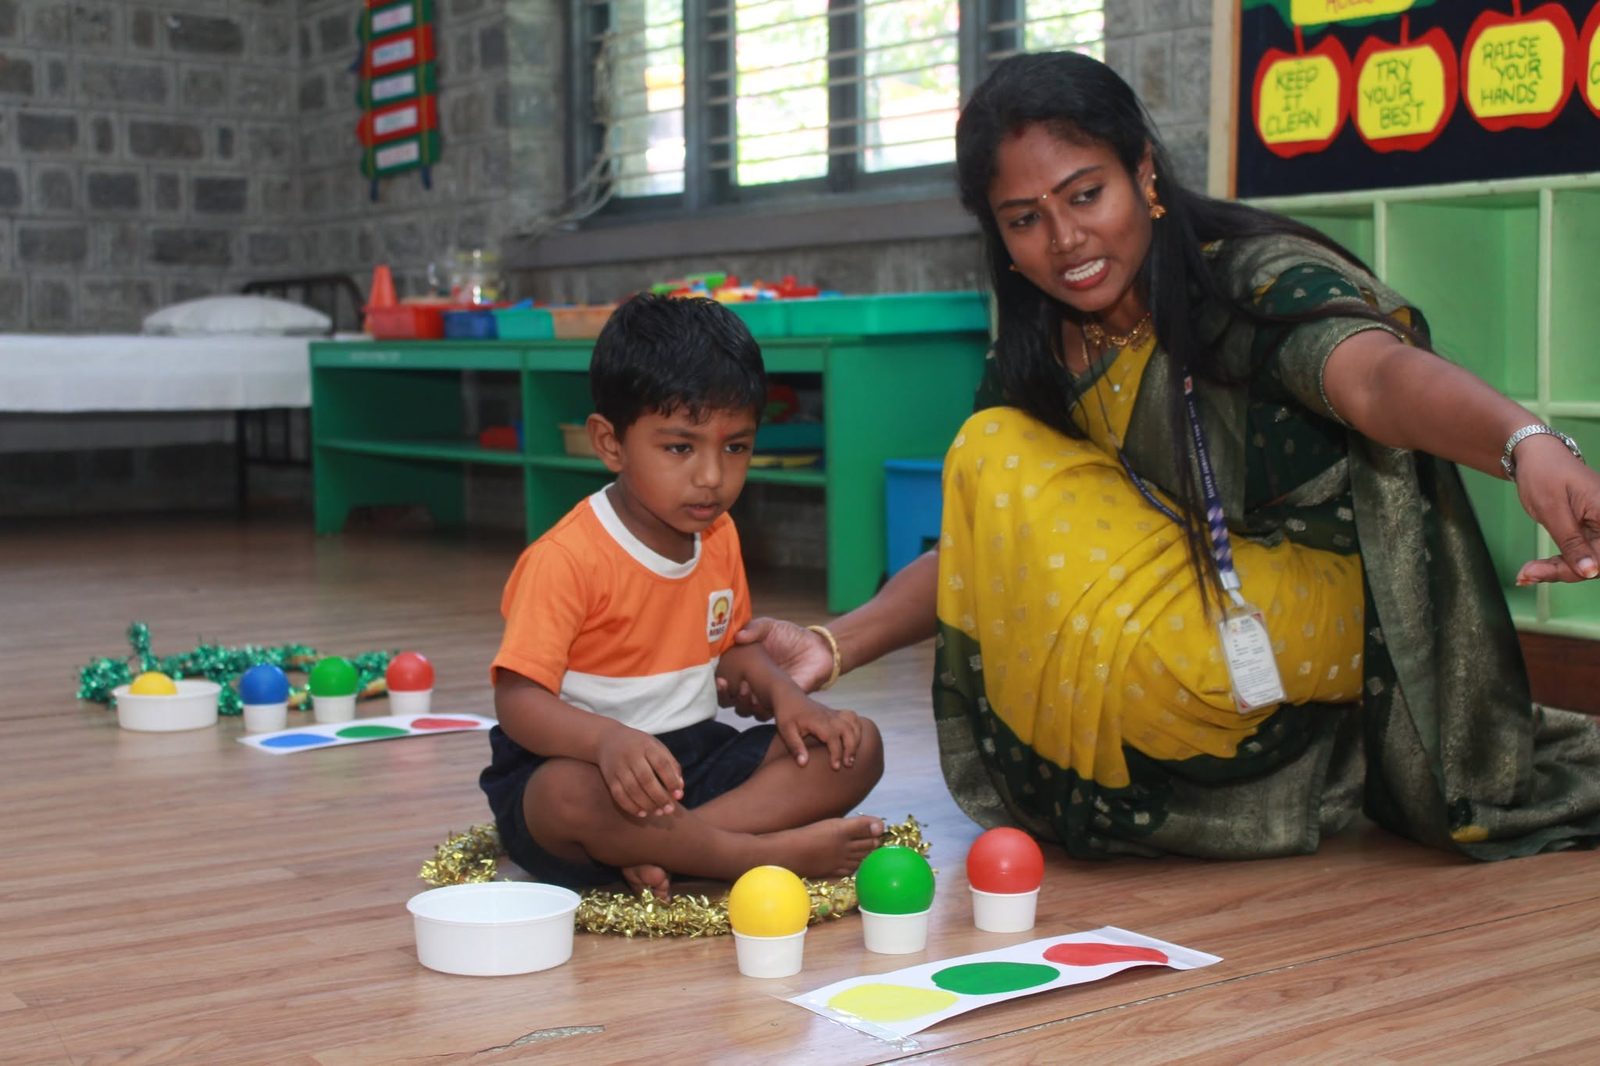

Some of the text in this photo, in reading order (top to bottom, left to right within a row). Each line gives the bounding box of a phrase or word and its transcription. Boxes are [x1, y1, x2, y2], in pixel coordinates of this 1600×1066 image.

[1481, 36, 1540, 69] RAISE
[1275, 66, 1319, 92] KEEP
[1376, 57, 1413, 82] TRY
[1495, 58, 1543, 84] YOUR
[1282, 94, 1304, 112] IT
[1363, 80, 1414, 108] YOUR
[1480, 80, 1538, 108] HANDS
[1265, 108, 1322, 136] CLEAN
[1380, 101, 1424, 129] BEST
